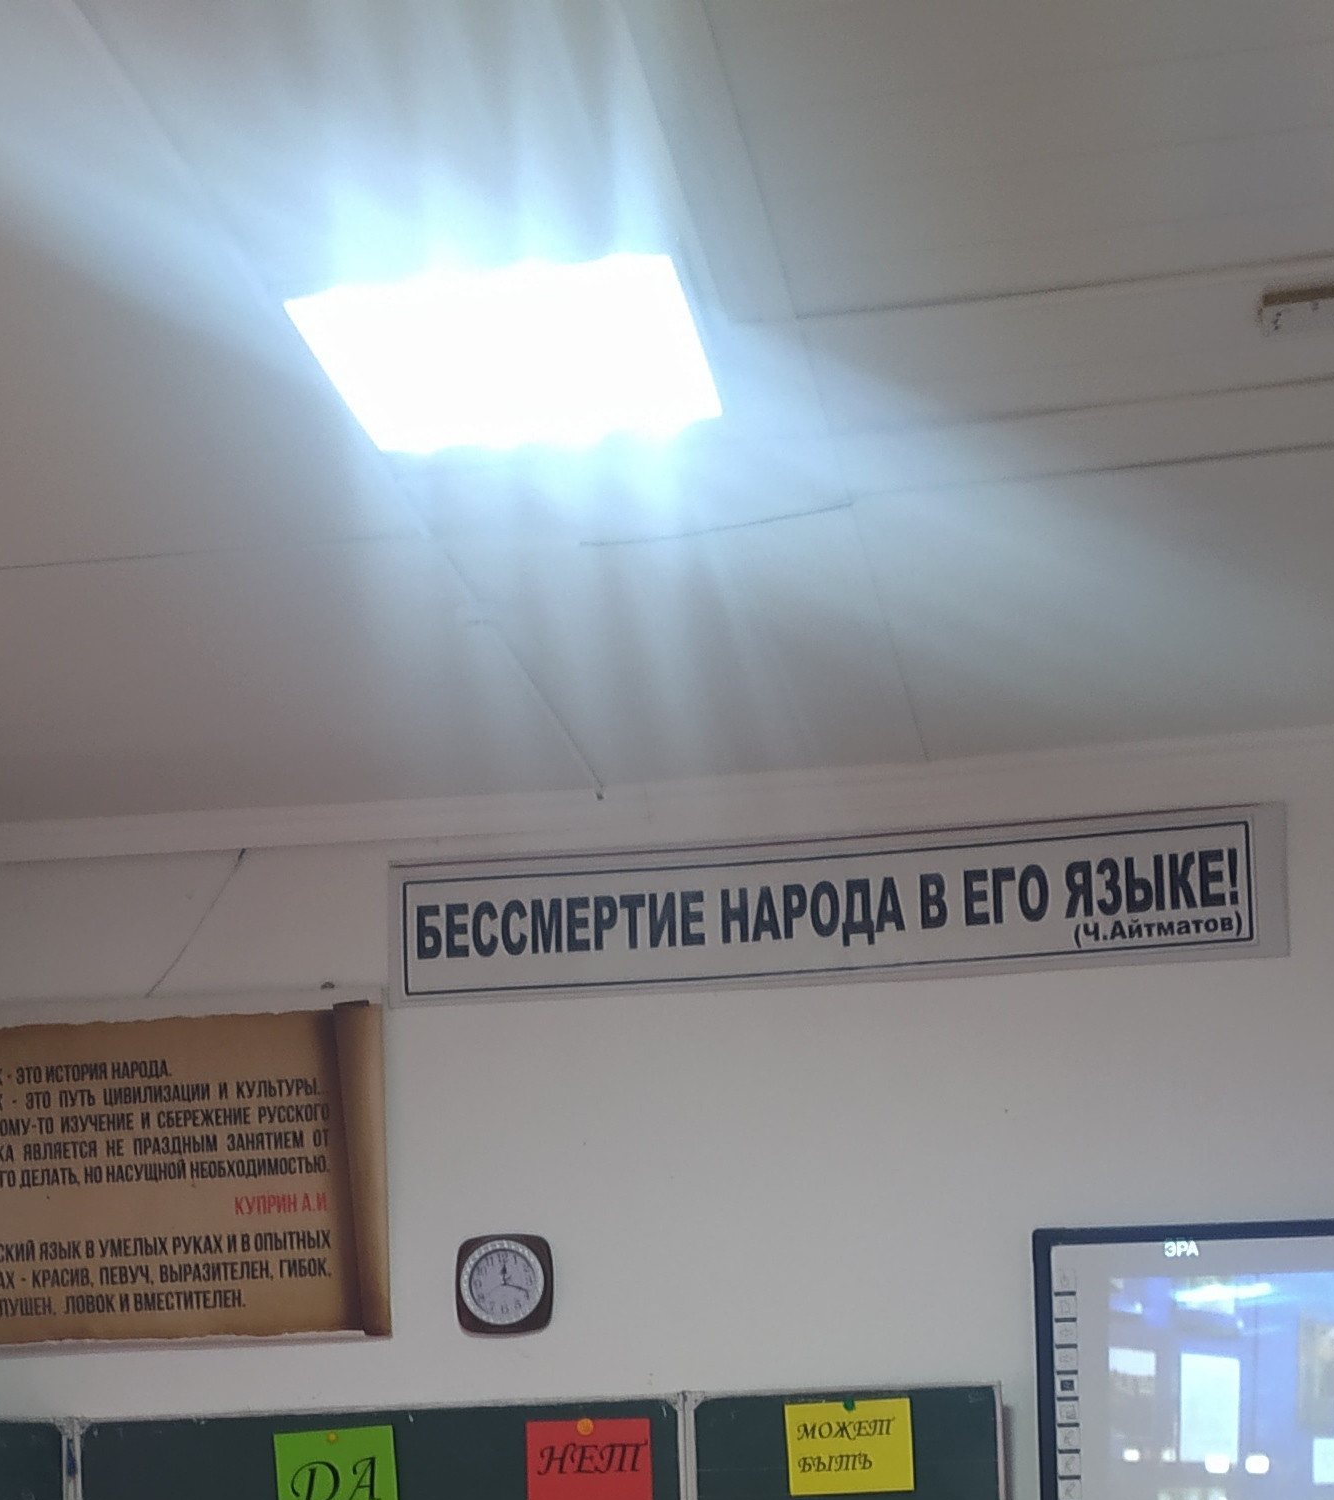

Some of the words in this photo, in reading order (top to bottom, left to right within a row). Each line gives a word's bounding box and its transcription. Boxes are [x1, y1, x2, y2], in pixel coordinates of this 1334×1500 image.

[417, 890, 706, 960] БЕССМЕРТИЕ
[720, 876, 906, 946] НАРОДА
[920, 872, 949, 930] В
[964, 863, 1050, 926] ЕГО
[1065, 848, 1240, 919] ЯЗЫКЕ!
[1073, 911, 1243, 948] (Ч.Айтматов)
[16, 1066, 42, 1084] ЭТО
[46, 1062, 107, 1083] ИСТОРИЯ
[111, 1059, 172, 1079] НАРОДА.
[25, 1091, 51, 1110] ЭТО
[59, 1089, 95, 1108] ПУТЬ
[103, 1082, 211, 1107] ЦИВИЛИЗАЦИИ
[218, 1081, 228, 1100] И
[61, 1112, 134, 1134] ИЗУЧЕНИЕ
[141, 1112, 150, 1129] И
[157, 1106, 251, 1129] СБЕРЕЖЕНИЕ
[258, 1103, 330, 1124] РУССКОГО
[23, 1140, 97, 1161] ЯВЛЯЕТСЯ
[106, 1138, 124, 1157] НЕ
[134, 1134, 218, 1157] ПРАЗДНЫМ
[227, 1130, 304, 1152] ЗАНЯТИЕМ
[313, 1128, 329, 1148] ОТ
[19, 1167, 80, 1189] ДЕЛАТЬ,
[84, 1165, 103, 1184] НО
[106, 1158, 186, 1183] НАСУЩНОЙ
[190, 1154, 330, 1180] НЕОБХОДИМОСТЬЮ.
[234, 1193, 297, 1215] КУПРИН
[39, 1240, 82, 1261] ЯЗЫК
[85, 1239, 95, 1259] В
[99, 1236, 168, 1258] УМЕЛЫХ
[172, 1234, 223, 1255] РУКАХ
[227, 1233, 237, 1253] И
[241, 1233, 251, 1252] В
[254, 1229, 331, 1252] ОПЫТНЫХ
[32, 1267, 95, 1288] КРАСИВ,
[99, 1264, 155, 1286] ПЕВУЧ,
[159, 1259, 274, 1284] ВЫРАЗИТЕЛЕН,
[64, 1294, 115, 1315] ЛОВОК
[119, 1293, 129, 1312] И
[134, 1289, 246, 1312] ВМЕСТИТЕЛЕН.
[797, 1416, 896, 1440] МОЖЕТ
[536, 1438, 649, 1476] НЕТ
[797, 1452, 873, 1473] БЫТЬ
